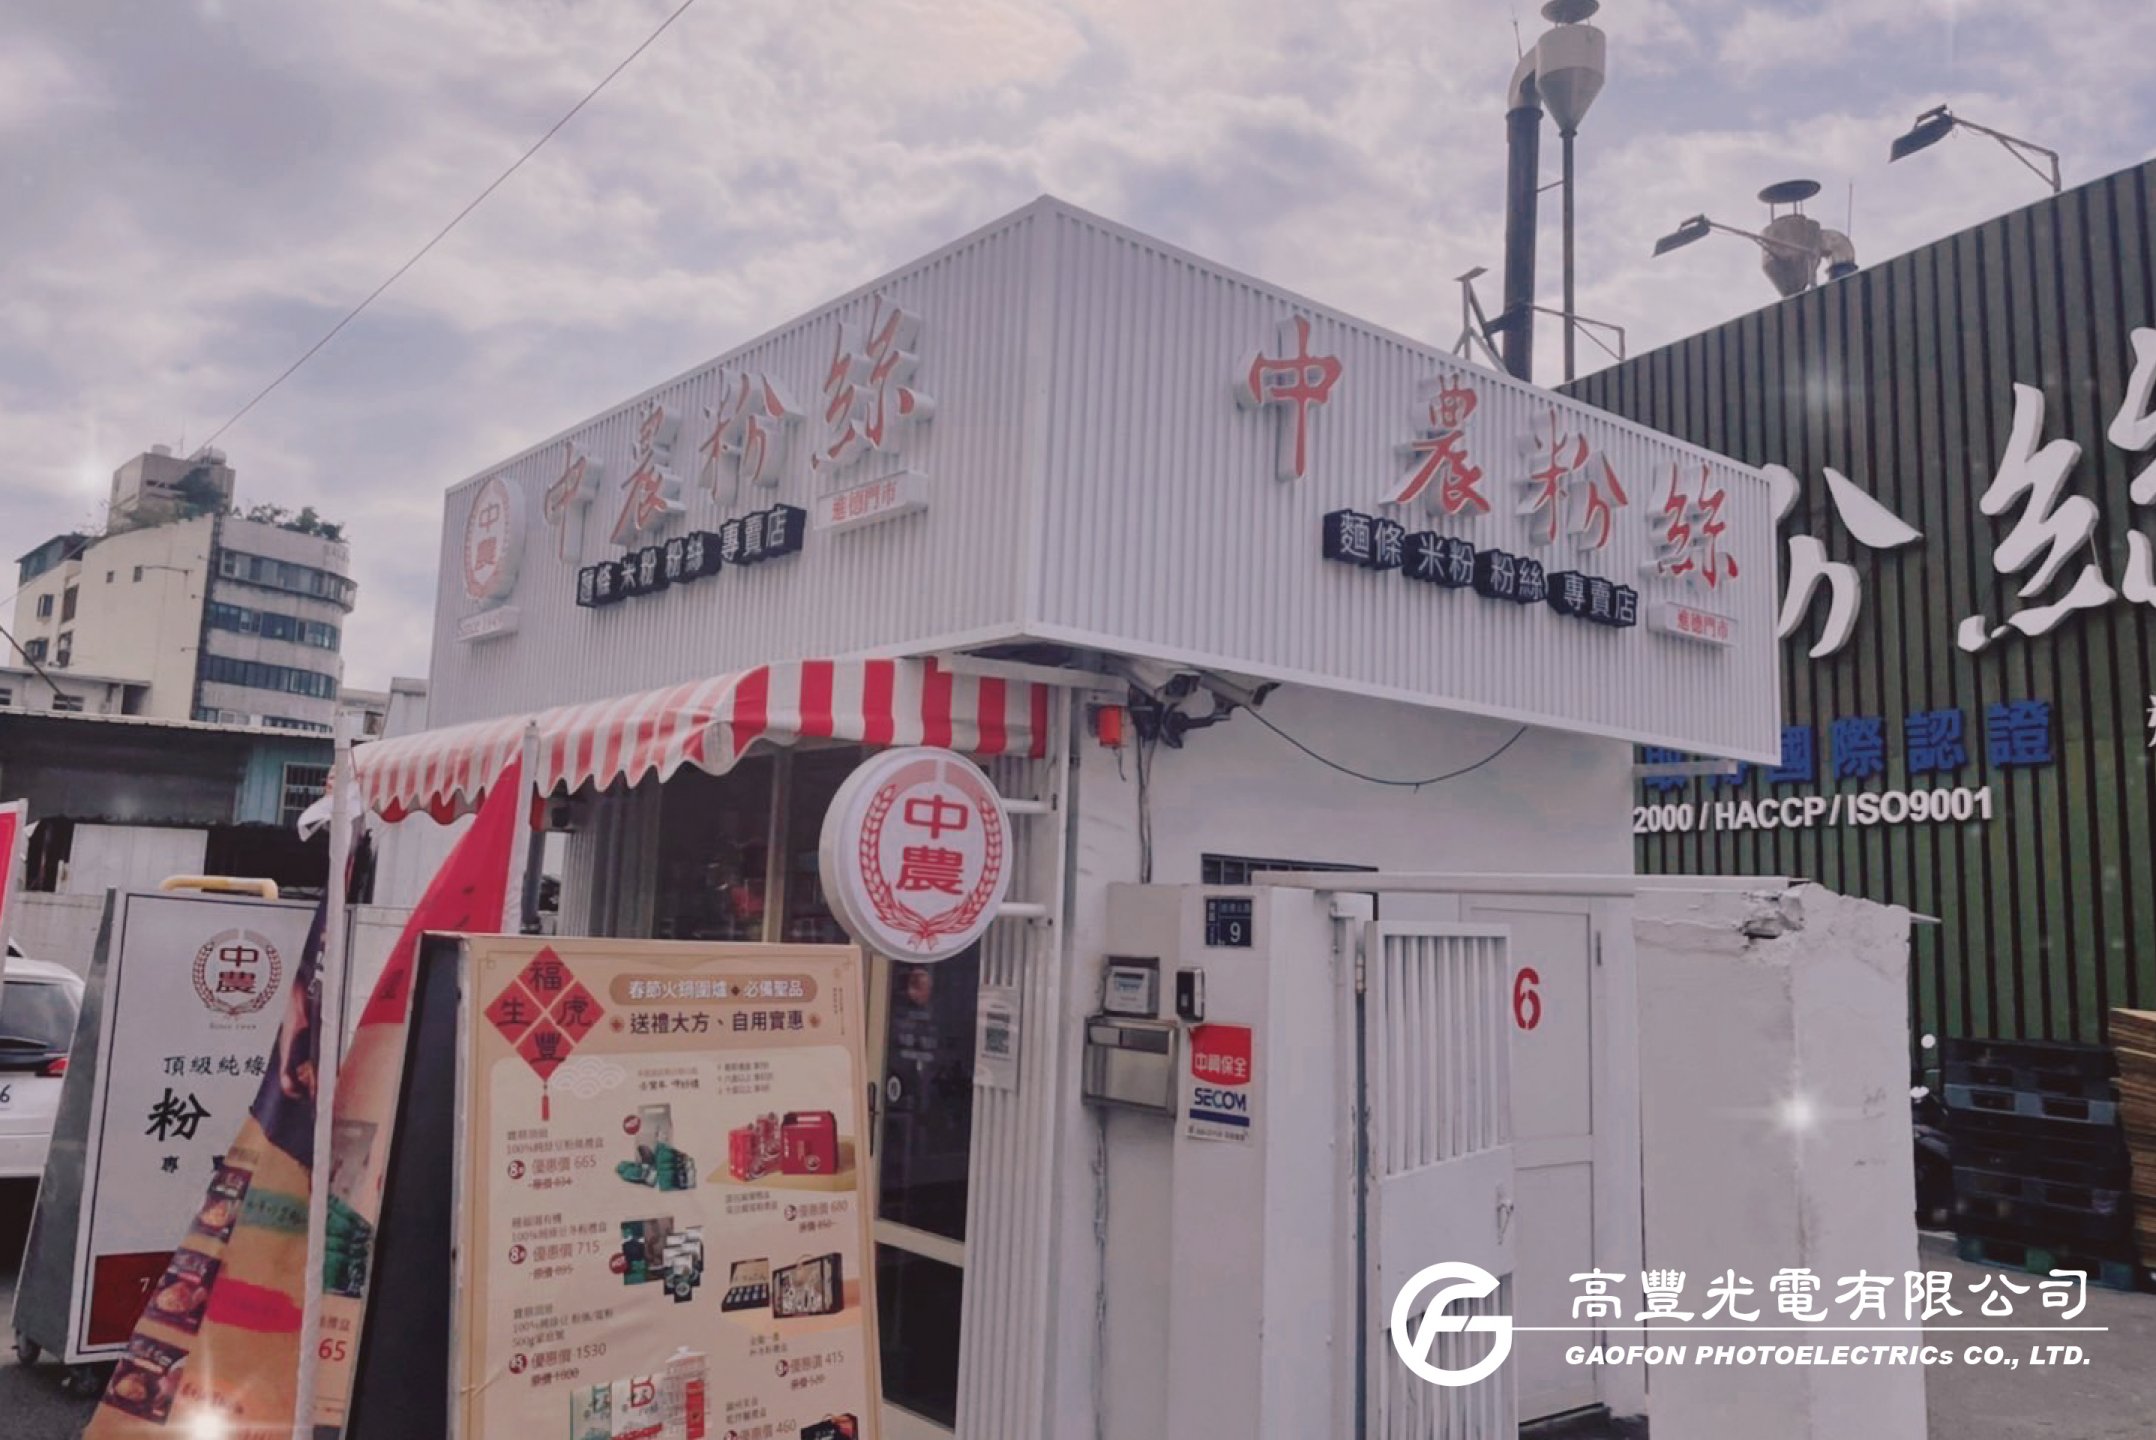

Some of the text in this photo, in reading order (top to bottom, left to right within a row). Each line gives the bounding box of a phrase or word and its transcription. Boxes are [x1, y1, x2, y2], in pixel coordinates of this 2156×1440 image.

[1249, 314, 1738, 589] 中農粉絲
[1715, 797, 1826, 830] HACCP
[1848, 786, 1993, 824] ISO9001
[896, 794, 969, 896] 中農
[1230, 921, 1241, 943] 9
[216, 945, 259, 994] 中農
[1512, 967, 1542, 1031] 6
[146, 1088, 211, 1142] 粉
[1194, 1087, 1247, 1112] SECOM
[576, 1241, 601, 1254] 715
[576, 1343, 607, 1359] 1530
